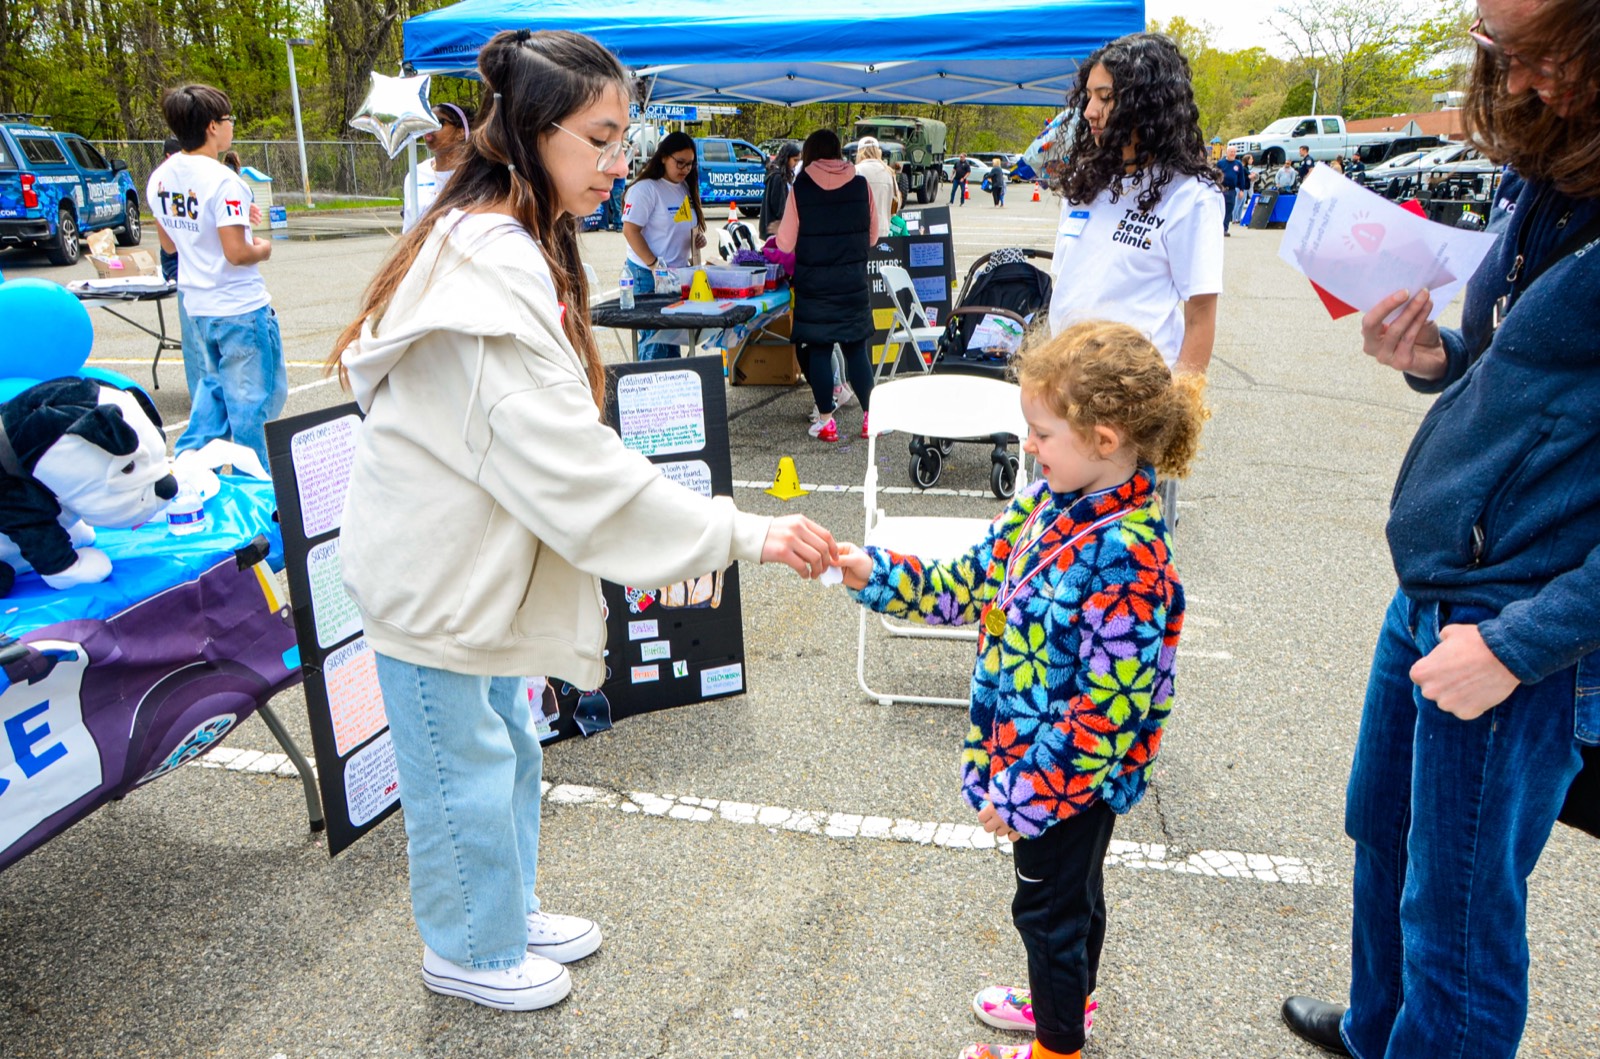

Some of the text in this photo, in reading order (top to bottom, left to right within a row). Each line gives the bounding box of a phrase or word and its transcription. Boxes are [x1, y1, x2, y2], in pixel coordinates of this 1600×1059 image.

[665, 107, 685, 116] WASH
[708, 172, 766, 187] UNDER PRESSUR
[713, 189, 765, 197] 973-879-2007
[157, 190, 198, 221] TBC
[1124, 209, 1165, 229] Teddy
[1117, 220, 1152, 236] Bear
[1112, 231, 1152, 250] Clinic
[620, 376, 653, 388] Additional
[666, 464, 681, 473] look
[775, 468, 782, 482] 2
